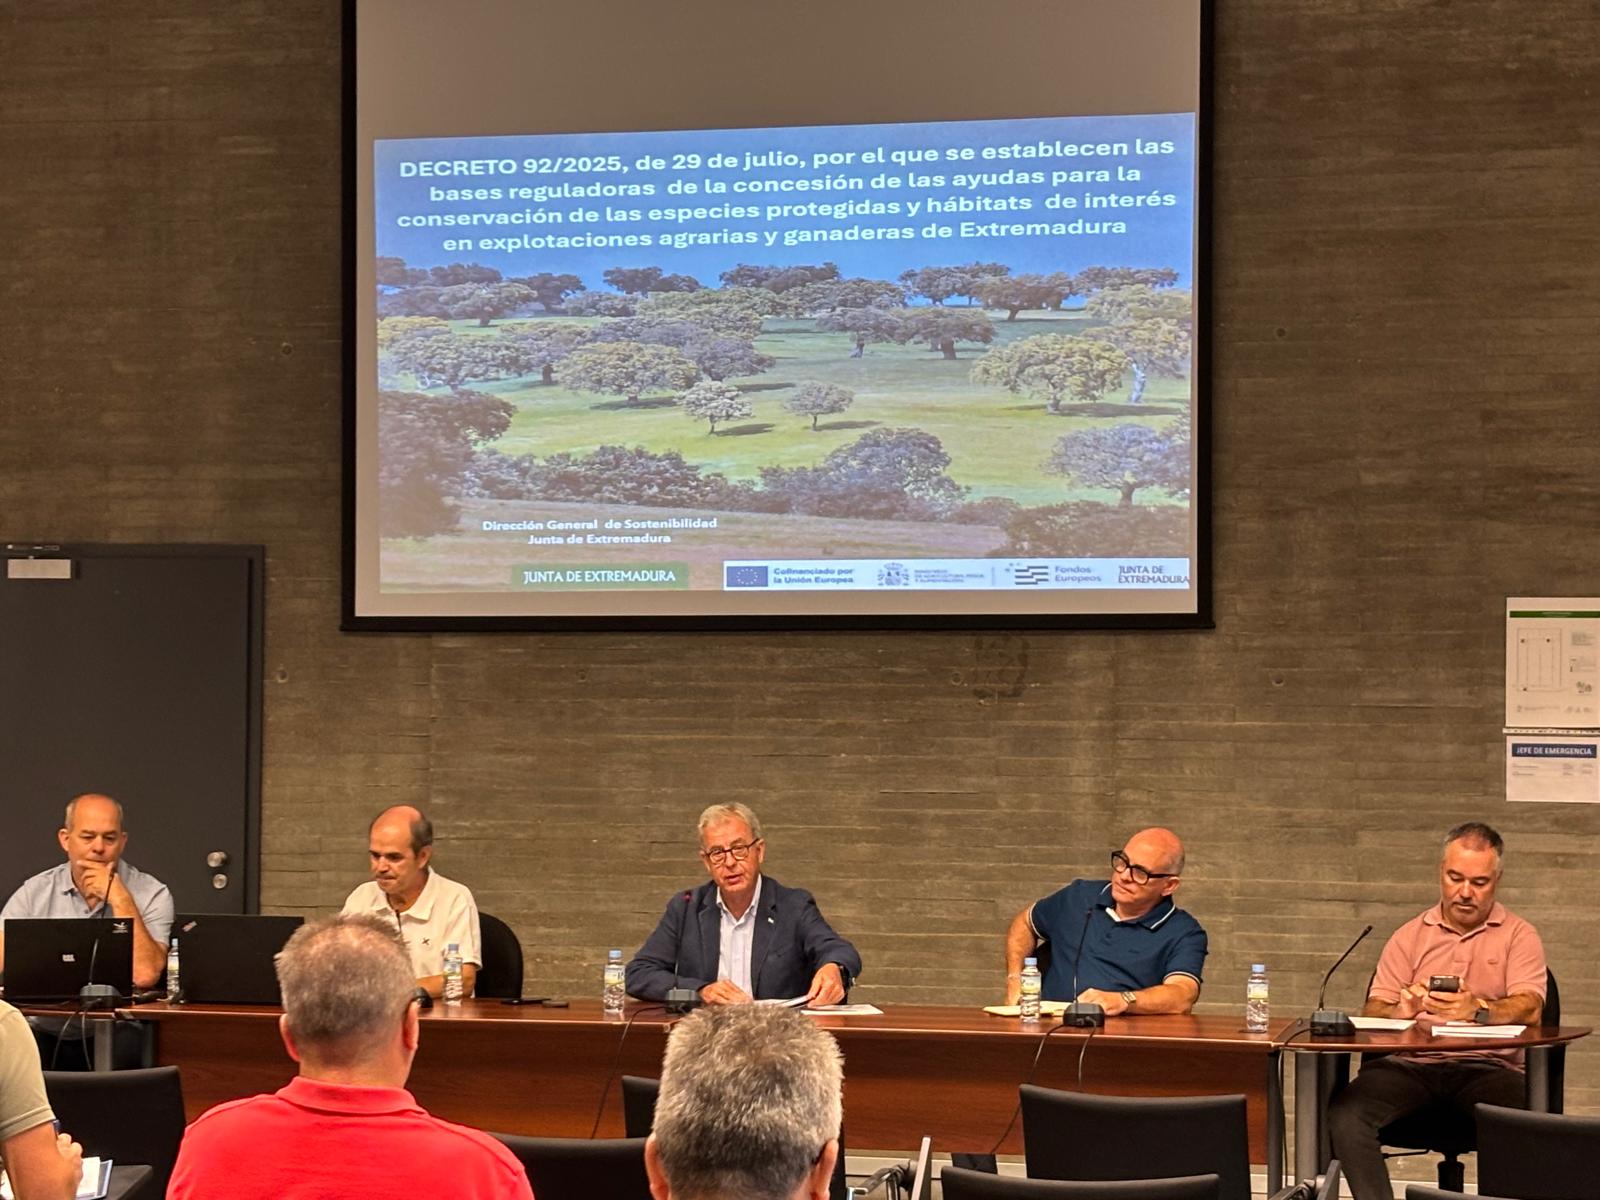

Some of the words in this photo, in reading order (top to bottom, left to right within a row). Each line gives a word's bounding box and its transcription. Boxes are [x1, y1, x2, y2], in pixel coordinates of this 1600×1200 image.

[399, 159, 517, 178] DECRETO
[523, 156, 629, 175] 92/2025,
[636, 154, 666, 172] de
[673, 154, 701, 170] 29
[707, 152, 739, 169] de
[743, 150, 807, 171] julio,
[813, 151, 855, 170] por
[861, 147, 885, 165] el
[891, 150, 939, 167] que
[946, 148, 975, 161] se
[982, 141, 1129, 160] establecen
[1135, 138, 1175, 156] las
[429, 185, 502, 202] bases
[509, 181, 656, 202] reguladoras
[667, 179, 698, 196] de
[705, 178, 726, 194] la
[733, 174, 864, 193] concesión
[870, 173, 902, 190] de
[908, 172, 946, 189] las
[952, 170, 1046, 190] ayudas
[1052, 169, 1111, 187] para
[1118, 165, 1142, 182] la
[397, 208, 563, 228] conservación
[569, 206, 600, 224] de
[606, 205, 642, 222] las
[648, 203, 761, 222] especies
[766, 199, 901, 220] protegidas
[906, 202, 921, 217] y
[927, 194, 1033, 214] hábitats
[1045, 193, 1078, 210] de
[1085, 190, 1177, 209] interés
[443, 237, 473, 251] en
[479, 231, 653, 254] explotaciones
[659, 228, 758, 248] agrarias
[764, 231, 779, 246] y
[783, 225, 915, 247] ganaderas
[921, 223, 953, 240] de
[960, 219, 1127, 239] Extremadura
[482, 520, 544, 531] Dirección
[546, 519, 598, 530] General
[604, 519, 622, 529] de
[624, 518, 718, 529] Sostenibilidad
[527, 535, 564, 545] Junta
[566, 534, 583, 544] de
[586, 534, 672, 544] Extremadura
[1119, 565, 1149, 575] JUNTA
[1152, 565, 1164, 574] DE
[523, 571, 563, 584] JUNTA
[566, 571, 581, 582] DE
[584, 570, 676, 582] EXTREMADURA
[1118, 575, 1190, 584] EXTREMADURA
[1533, 747, 1544, 755] DE
[1545, 747, 1592, 755] EMERGENCIA
